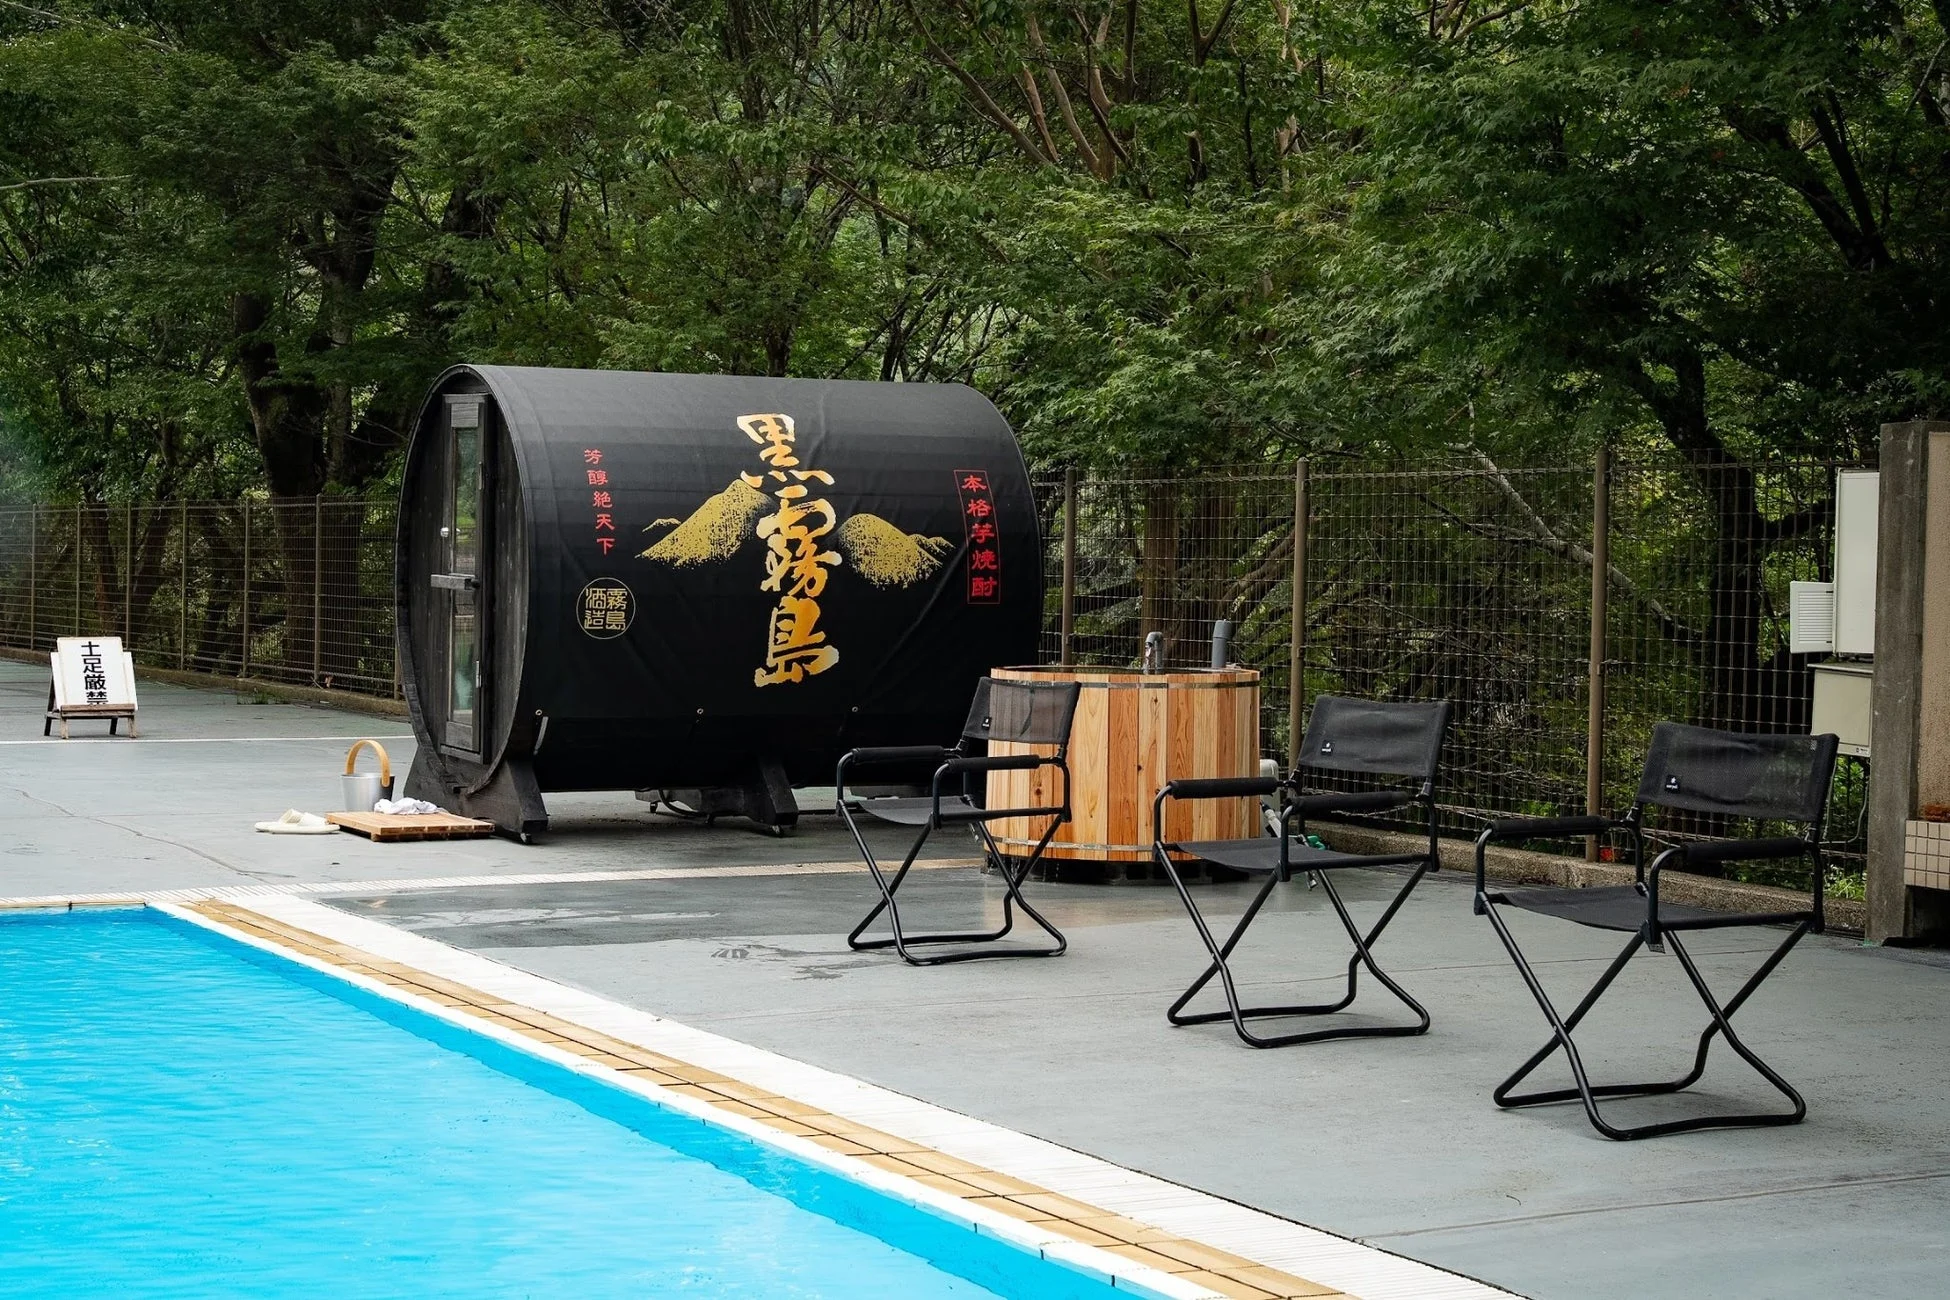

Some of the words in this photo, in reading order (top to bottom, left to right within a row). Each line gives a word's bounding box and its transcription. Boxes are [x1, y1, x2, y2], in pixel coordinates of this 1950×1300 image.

[584, 449, 616, 555] 芳醇絶天下
[737, 413, 842, 687] 黒霧島
[962, 474, 998, 597] 本格芋焼酎
